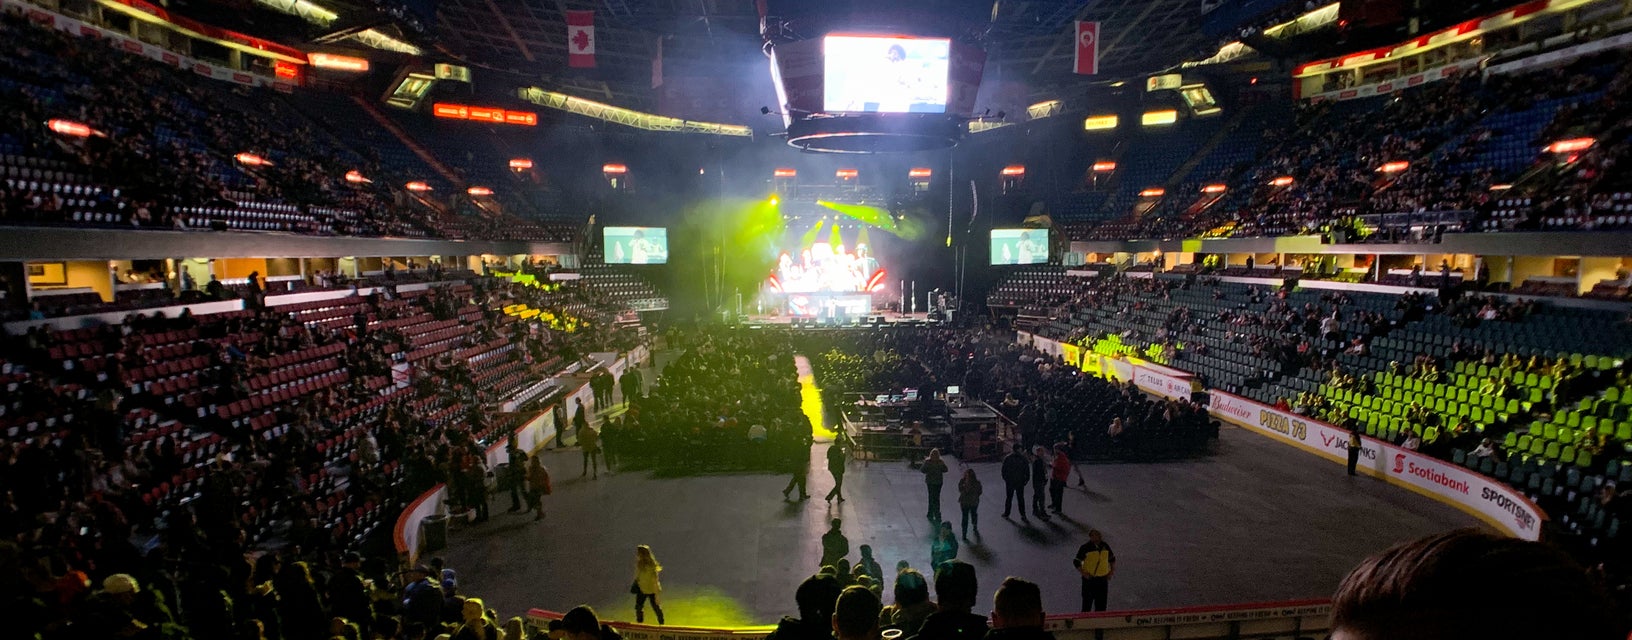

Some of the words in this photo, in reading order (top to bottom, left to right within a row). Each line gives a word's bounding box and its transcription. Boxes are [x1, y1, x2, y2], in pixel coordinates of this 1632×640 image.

[1147, 375, 1163, 387] TELUS
[1211, 394, 1252, 419] Budweiser
[1259, 409, 1289, 435] PIZZA
[1292, 419, 1307, 441] 73
[1408, 462, 1470, 495] Scotiabank
[1481, 486, 1536, 531] SPORTSNET
